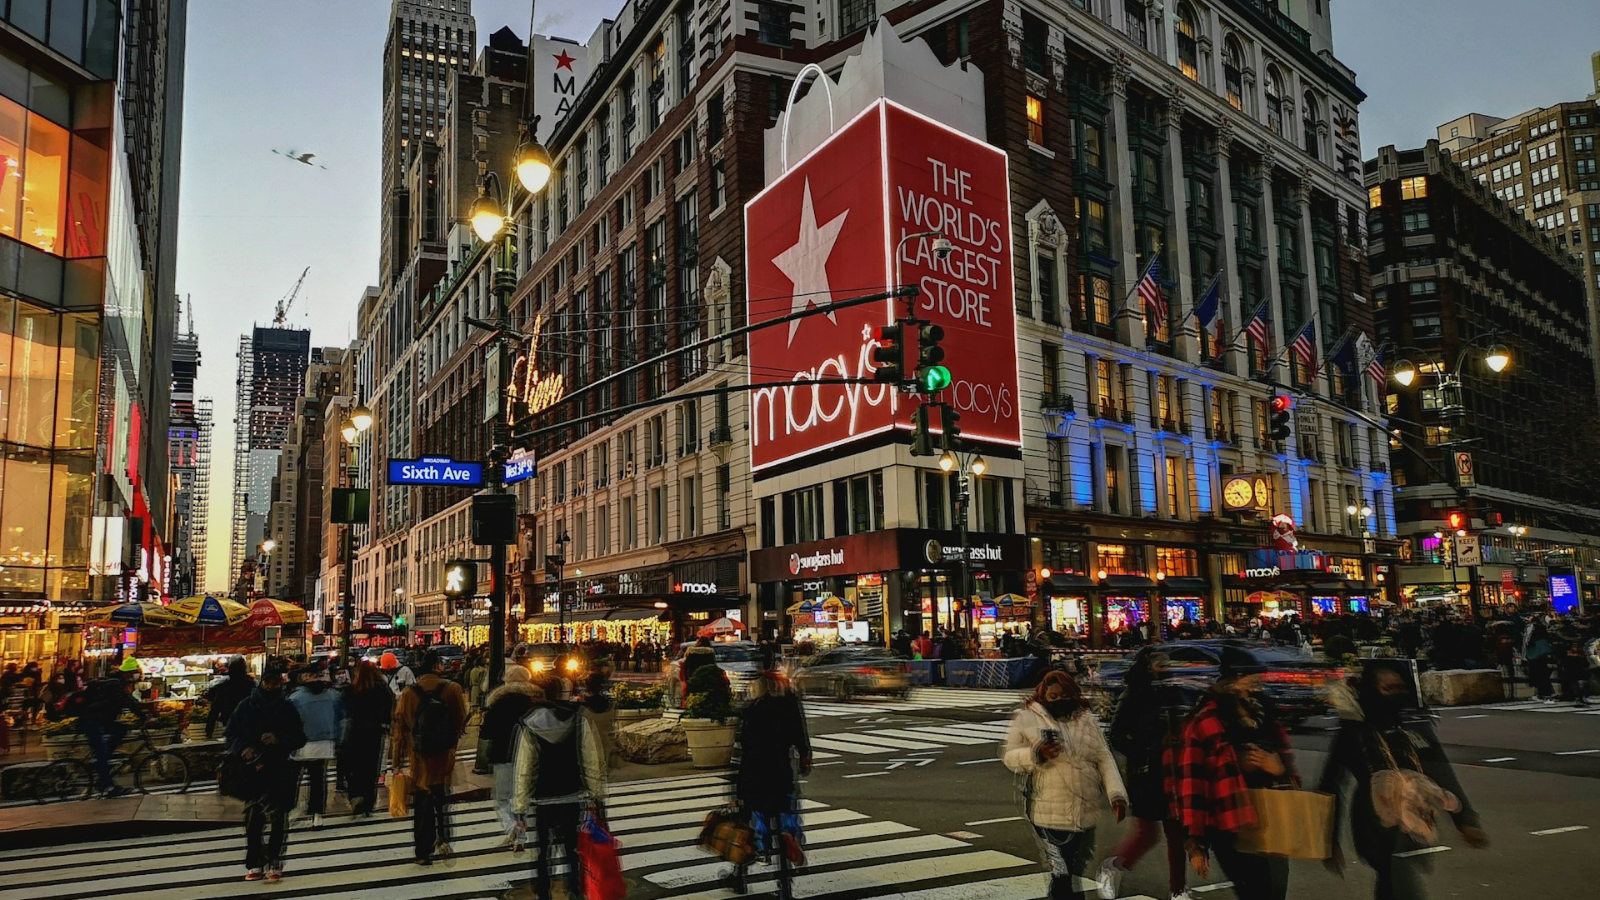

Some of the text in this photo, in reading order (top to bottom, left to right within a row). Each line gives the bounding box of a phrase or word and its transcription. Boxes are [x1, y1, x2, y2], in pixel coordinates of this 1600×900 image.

[926, 155, 973, 206] THE
[897, 185, 1003, 254] WORLD'S
[920, 275, 992, 328] STORE
[1298, 406, 1316, 414] BUSES
[402, 465, 470, 481] Sixth Ave
[504, 463, 517, 478] West
[800, 548, 845, 572] sunglass hut
[942, 543, 1003, 560] suass hut
[1246, 565, 1280, 579] macy's
[128, 576, 139, 603] FAMOU
[681, 582, 717, 595] macy's
